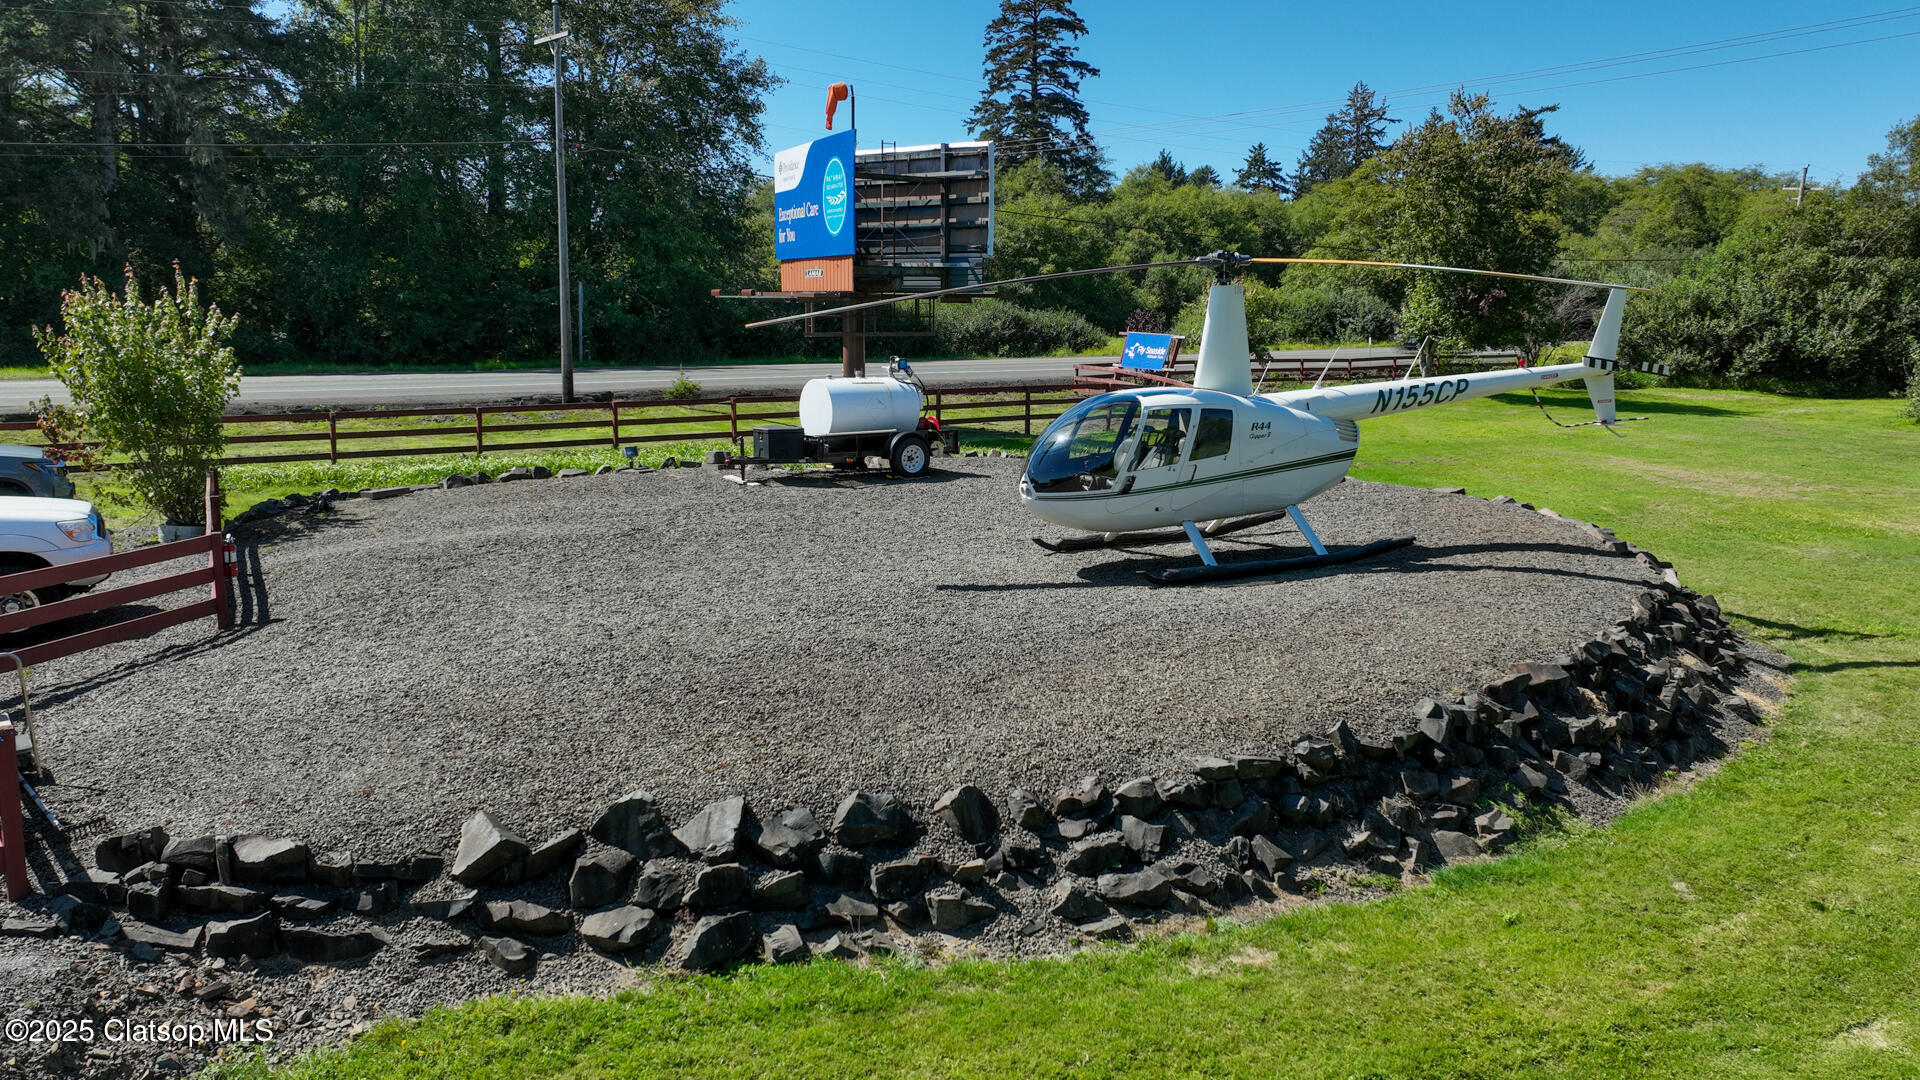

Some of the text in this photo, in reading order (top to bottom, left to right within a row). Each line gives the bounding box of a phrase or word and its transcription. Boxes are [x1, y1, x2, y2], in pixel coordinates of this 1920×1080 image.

[778, 201, 819, 224] Exceptional Care
[778, 227, 796, 243] for You
[1137, 345, 1167, 356] Fly Seaside
[1370, 378, 1469, 414] N155CP
[1250, 421, 1271, 431] R44
